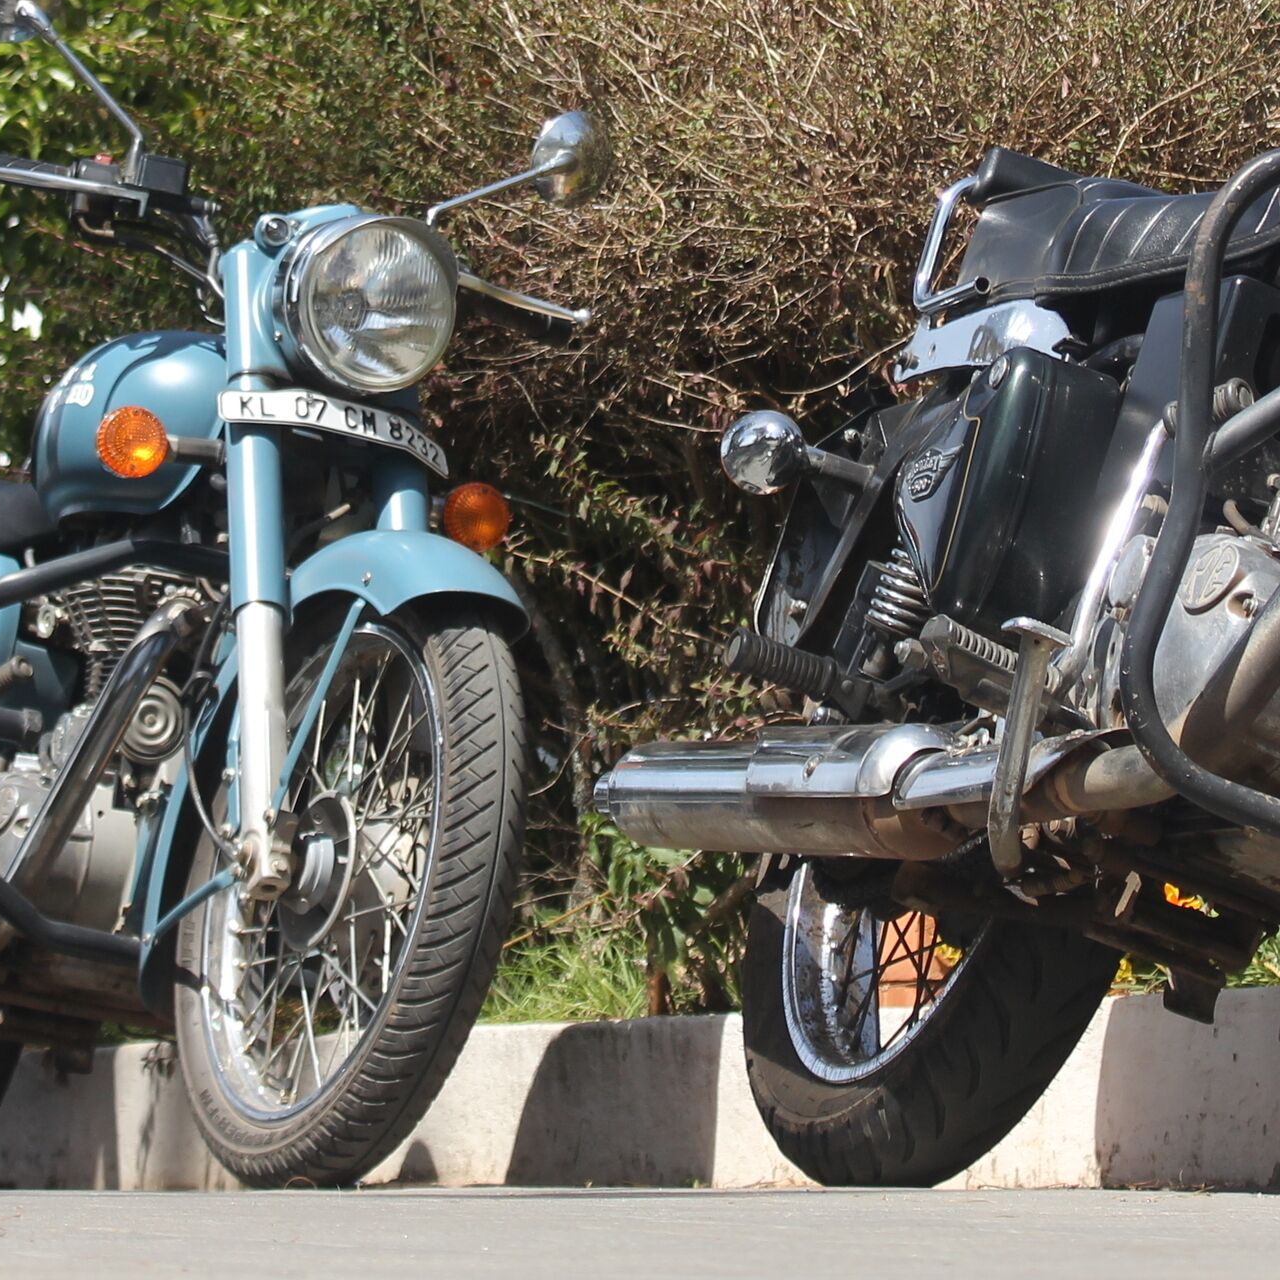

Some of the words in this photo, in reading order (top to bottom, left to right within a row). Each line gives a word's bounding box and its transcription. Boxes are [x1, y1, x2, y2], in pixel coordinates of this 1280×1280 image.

[239, 396, 276, 417] KL
[295, 396, 328, 422] 07
[389, 416, 441, 468] 8232
